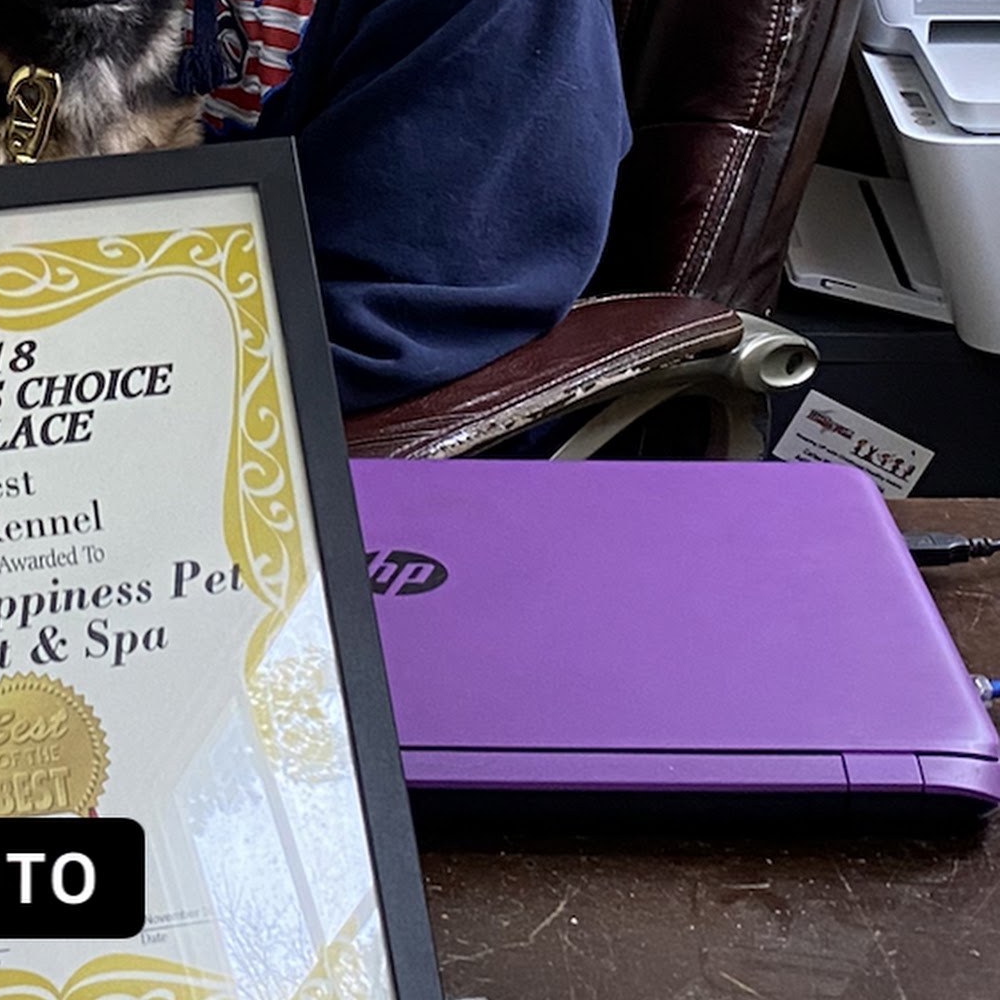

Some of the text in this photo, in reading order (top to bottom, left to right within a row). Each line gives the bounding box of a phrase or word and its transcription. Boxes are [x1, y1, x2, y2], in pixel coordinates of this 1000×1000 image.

[17, 363, 173, 411] CHOICE
[81, 544, 106, 565] To
[367, 551, 436, 595] hp
[171, 559, 245, 598] Pet
[30, 624, 69, 666] &
[85, 618, 169, 667] Spa
[24, 745, 61, 767] THE
[141, 933, 168, 945] Date
